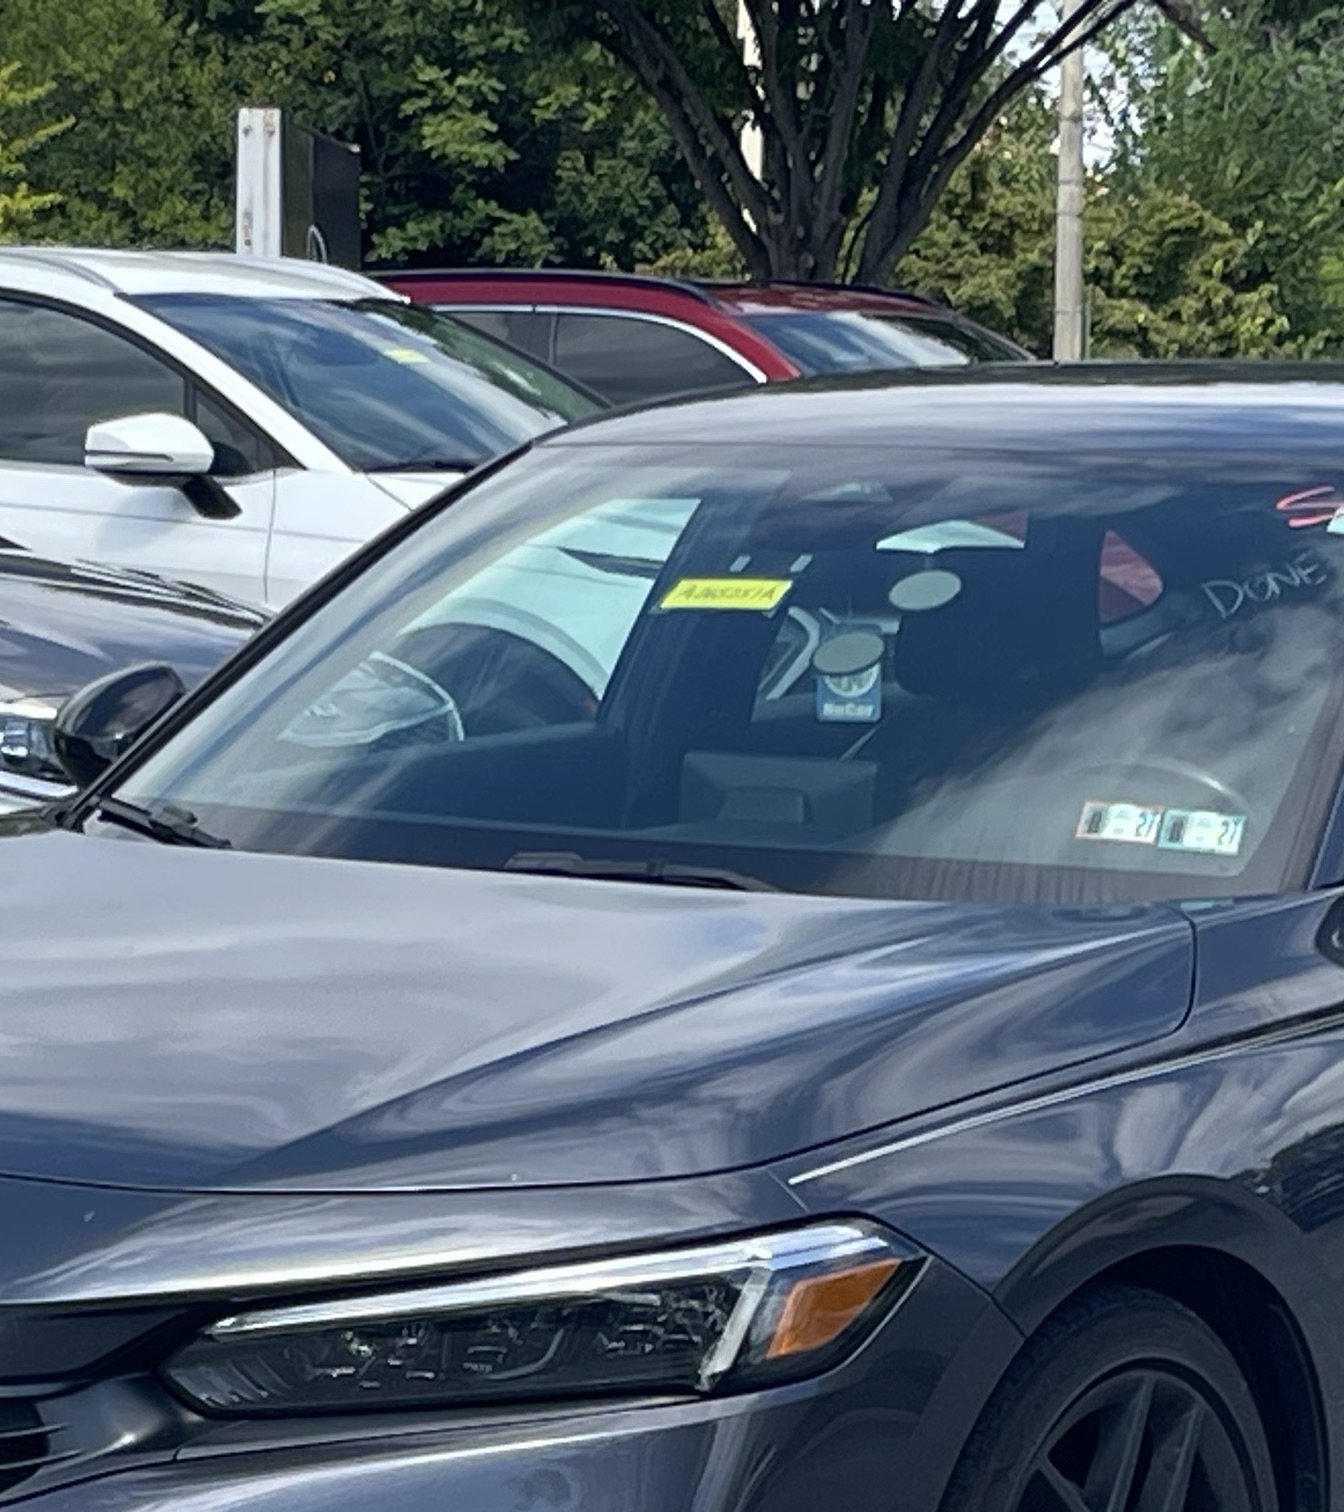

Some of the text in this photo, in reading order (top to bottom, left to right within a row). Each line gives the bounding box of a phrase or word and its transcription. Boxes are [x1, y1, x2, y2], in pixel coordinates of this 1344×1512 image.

[1201, 552, 1328, 620] DONE
[1134, 810, 1159, 838] 27
[1217, 816, 1243, 846] 27
